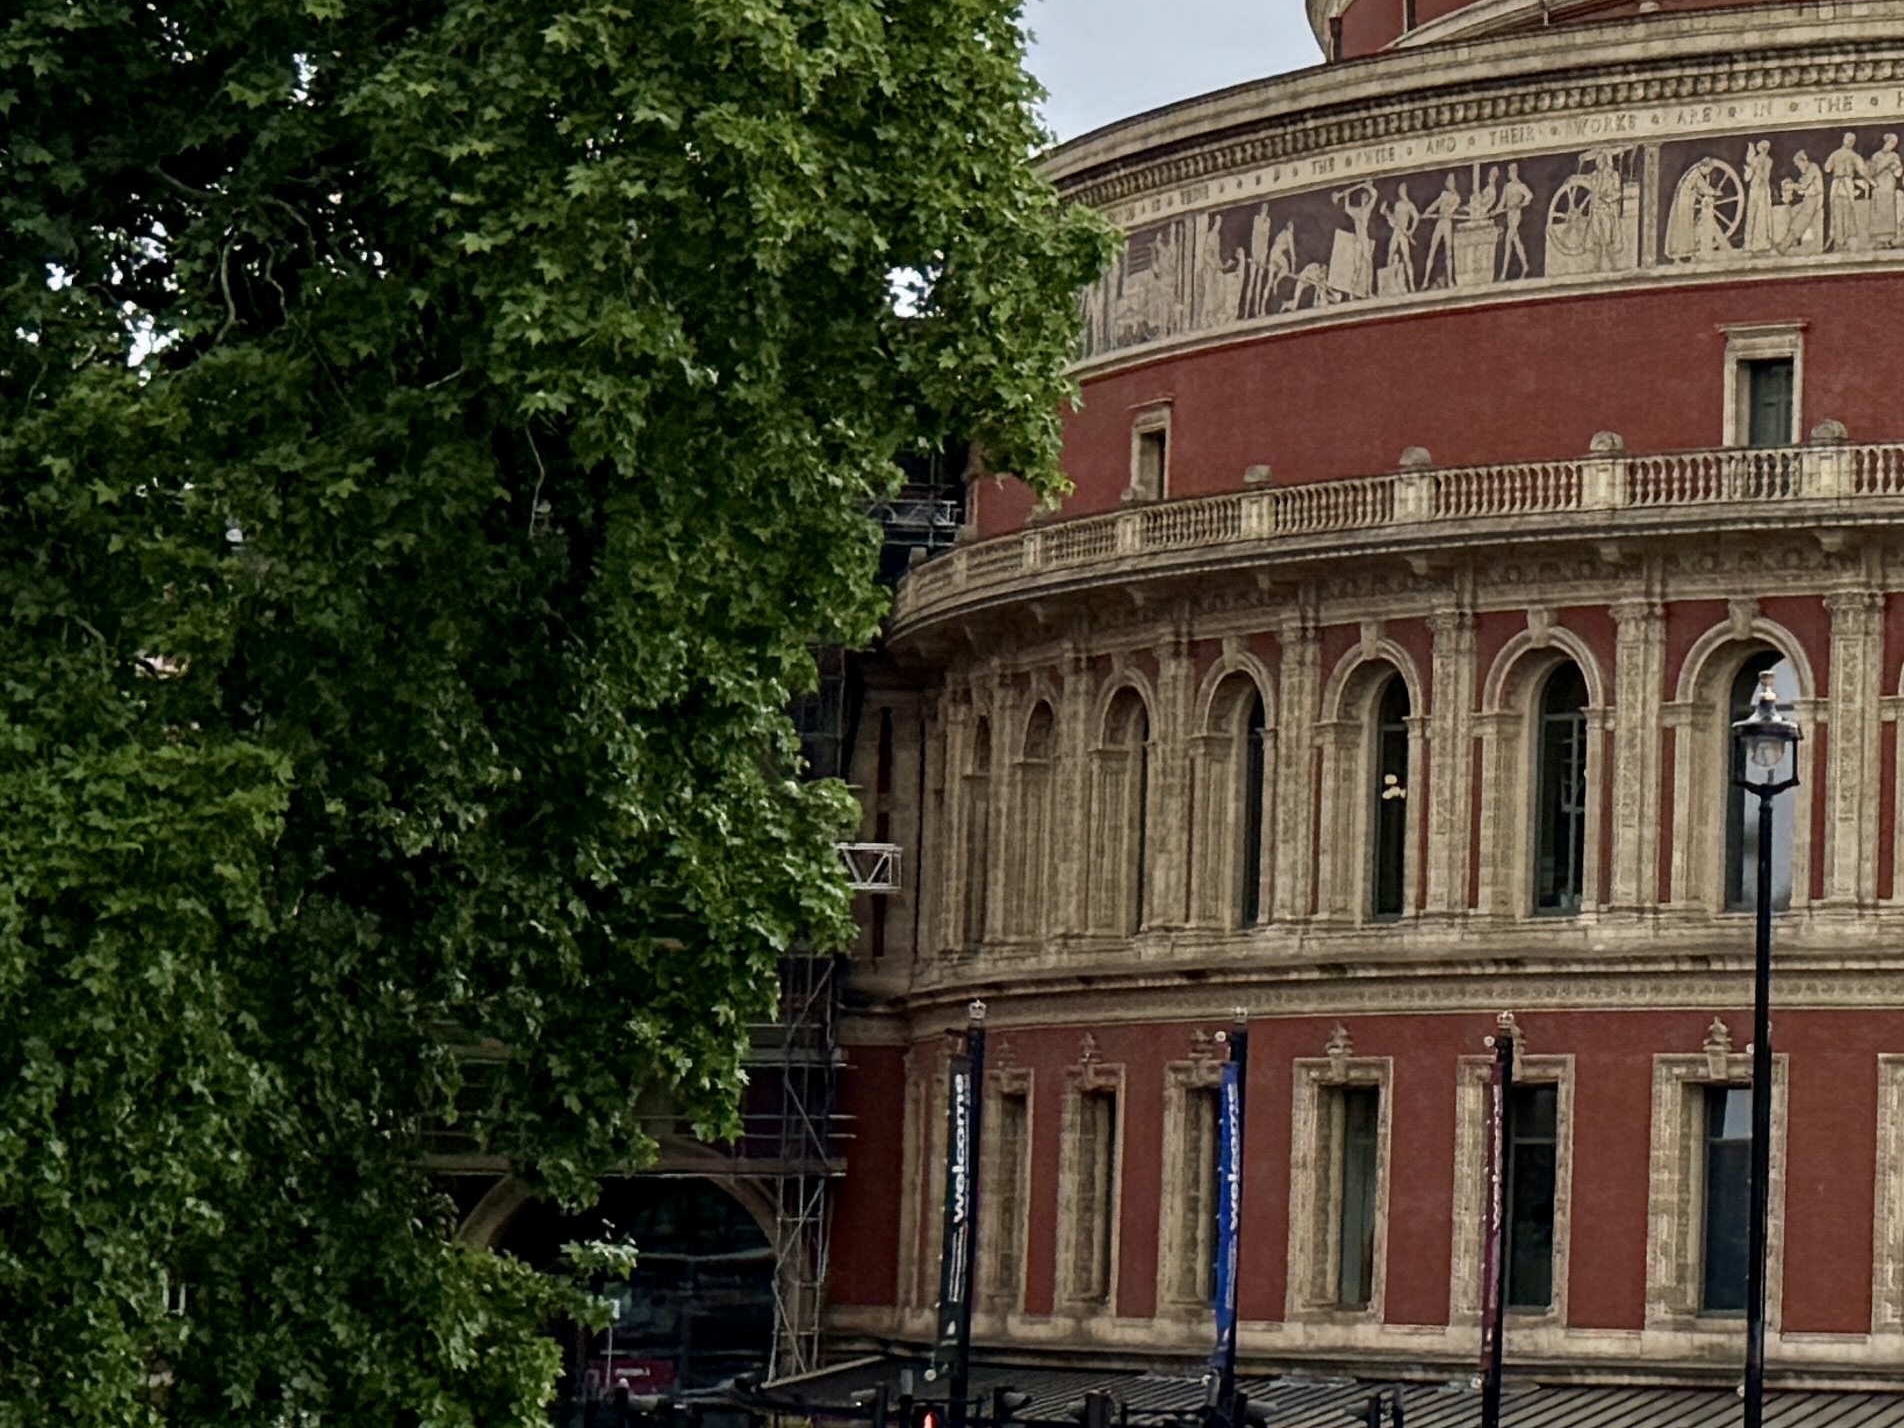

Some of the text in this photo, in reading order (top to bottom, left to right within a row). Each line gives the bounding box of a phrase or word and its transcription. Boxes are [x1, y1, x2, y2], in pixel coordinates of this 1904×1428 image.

[1425, 136, 1457, 156] AND
[1489, 125, 1536, 146] THEIR
[1573, 113, 1637, 135] WORKS
[1676, 106, 1713, 125] ARE
[1753, 102, 1772, 118] IN
[1813, 95, 1854, 114] THE
[952, 1074, 964, 1223] welcome
